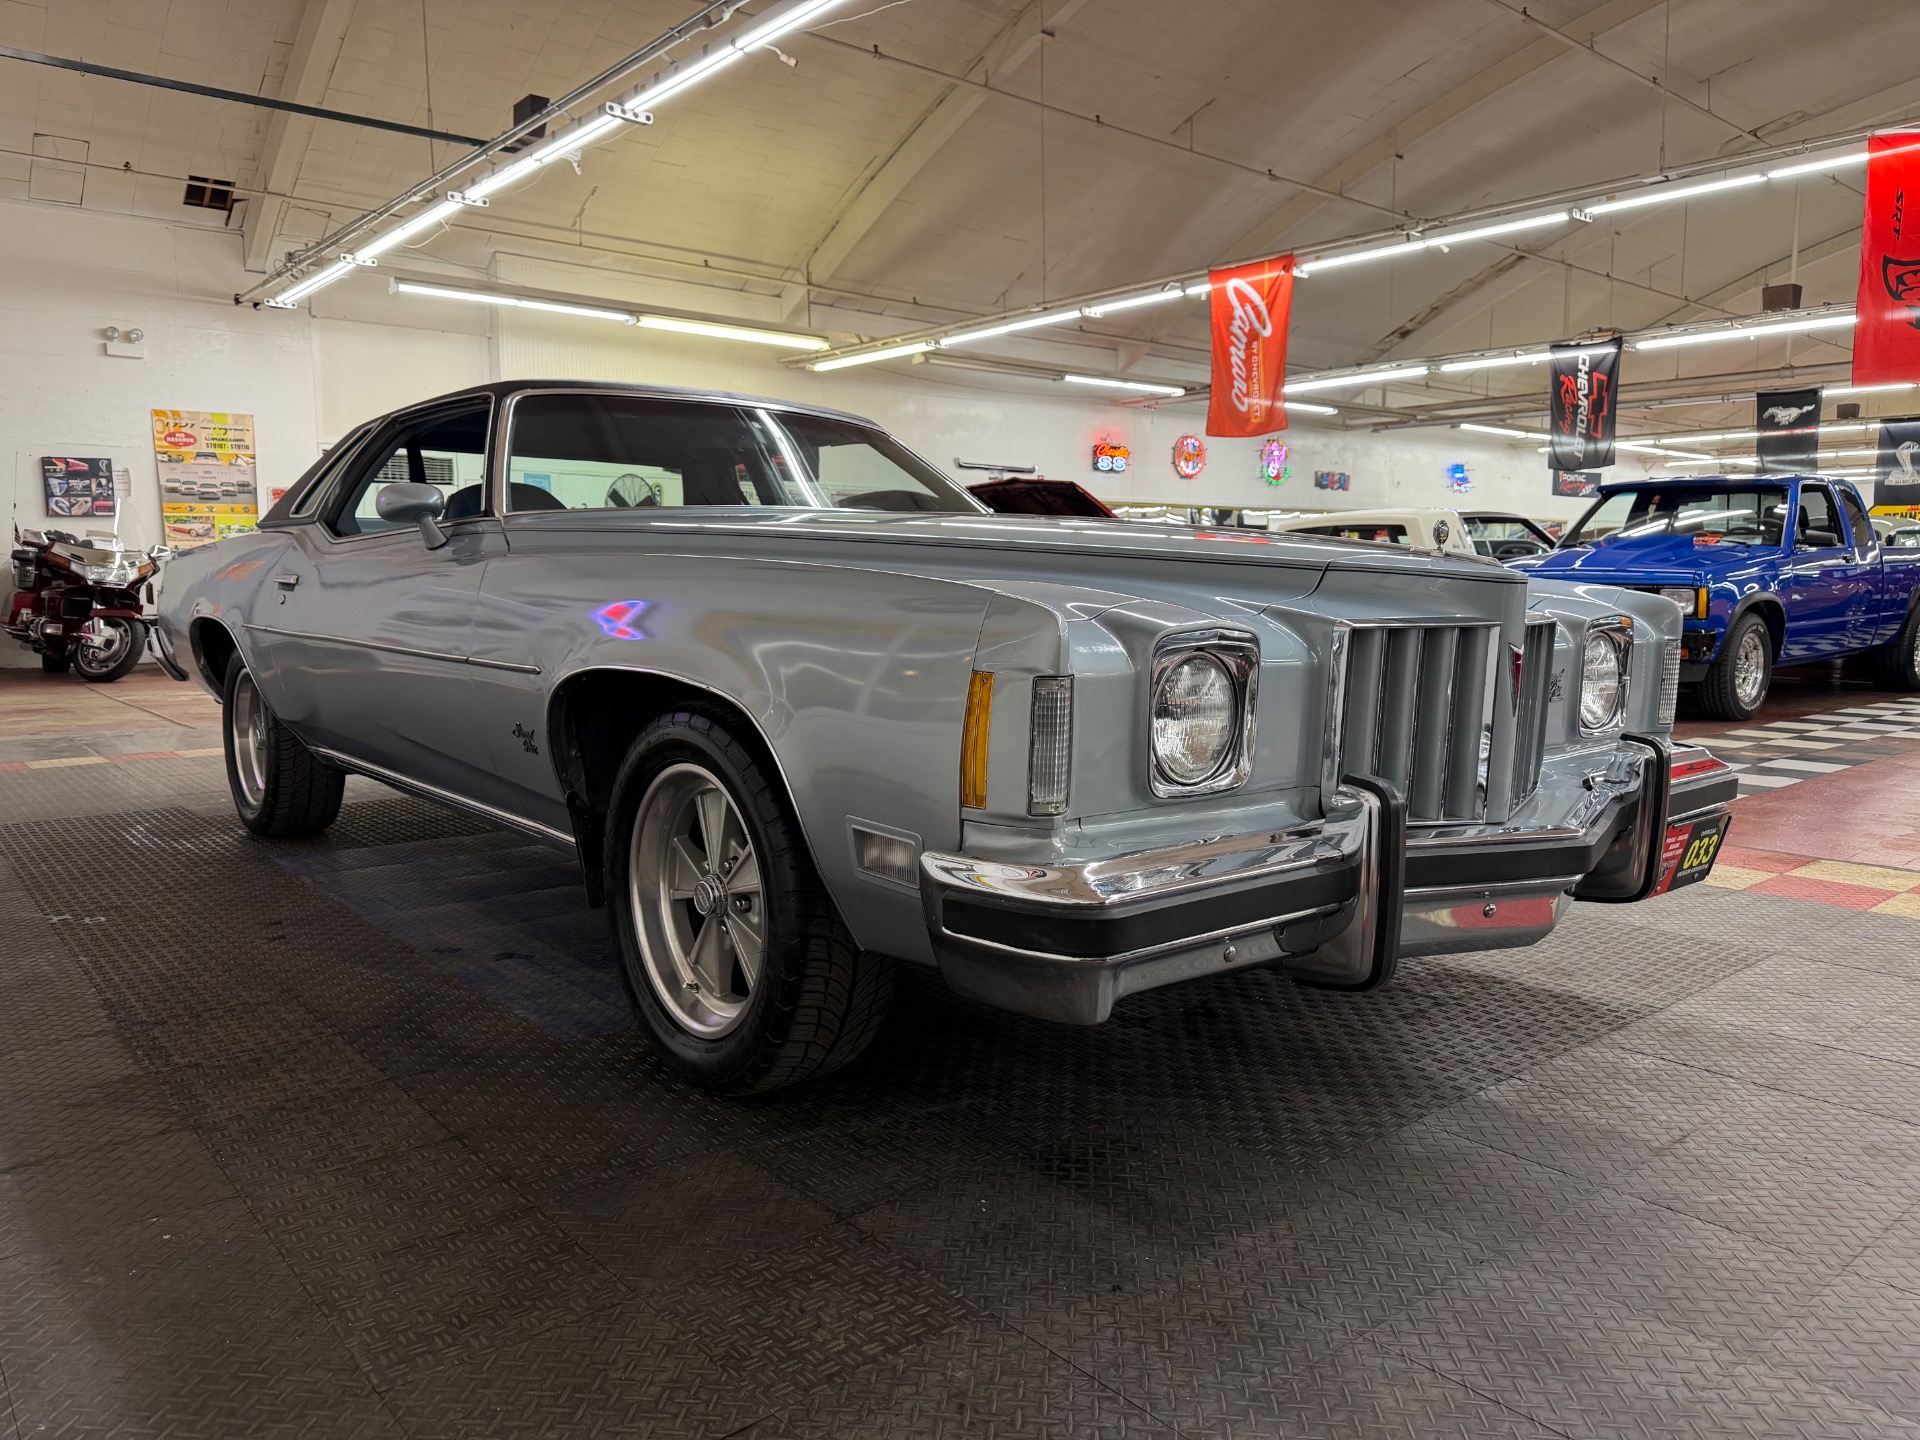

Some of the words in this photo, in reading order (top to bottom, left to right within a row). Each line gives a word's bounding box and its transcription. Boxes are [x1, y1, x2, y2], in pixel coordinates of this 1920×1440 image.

[1895, 187, 1905, 241] SRT
[1226, 278, 1273, 413] Camaro
[1251, 341, 1259, 354] BY
[1251, 355, 1261, 418] CHEVROLET
[1559, 374, 1578, 436] Racing
[1573, 354, 1590, 462] CHEVROLET
[1097, 456, 1127, 471] SS
[1562, 473, 1587, 482] PONTIAC
[1682, 834, 1719, 869] 033
